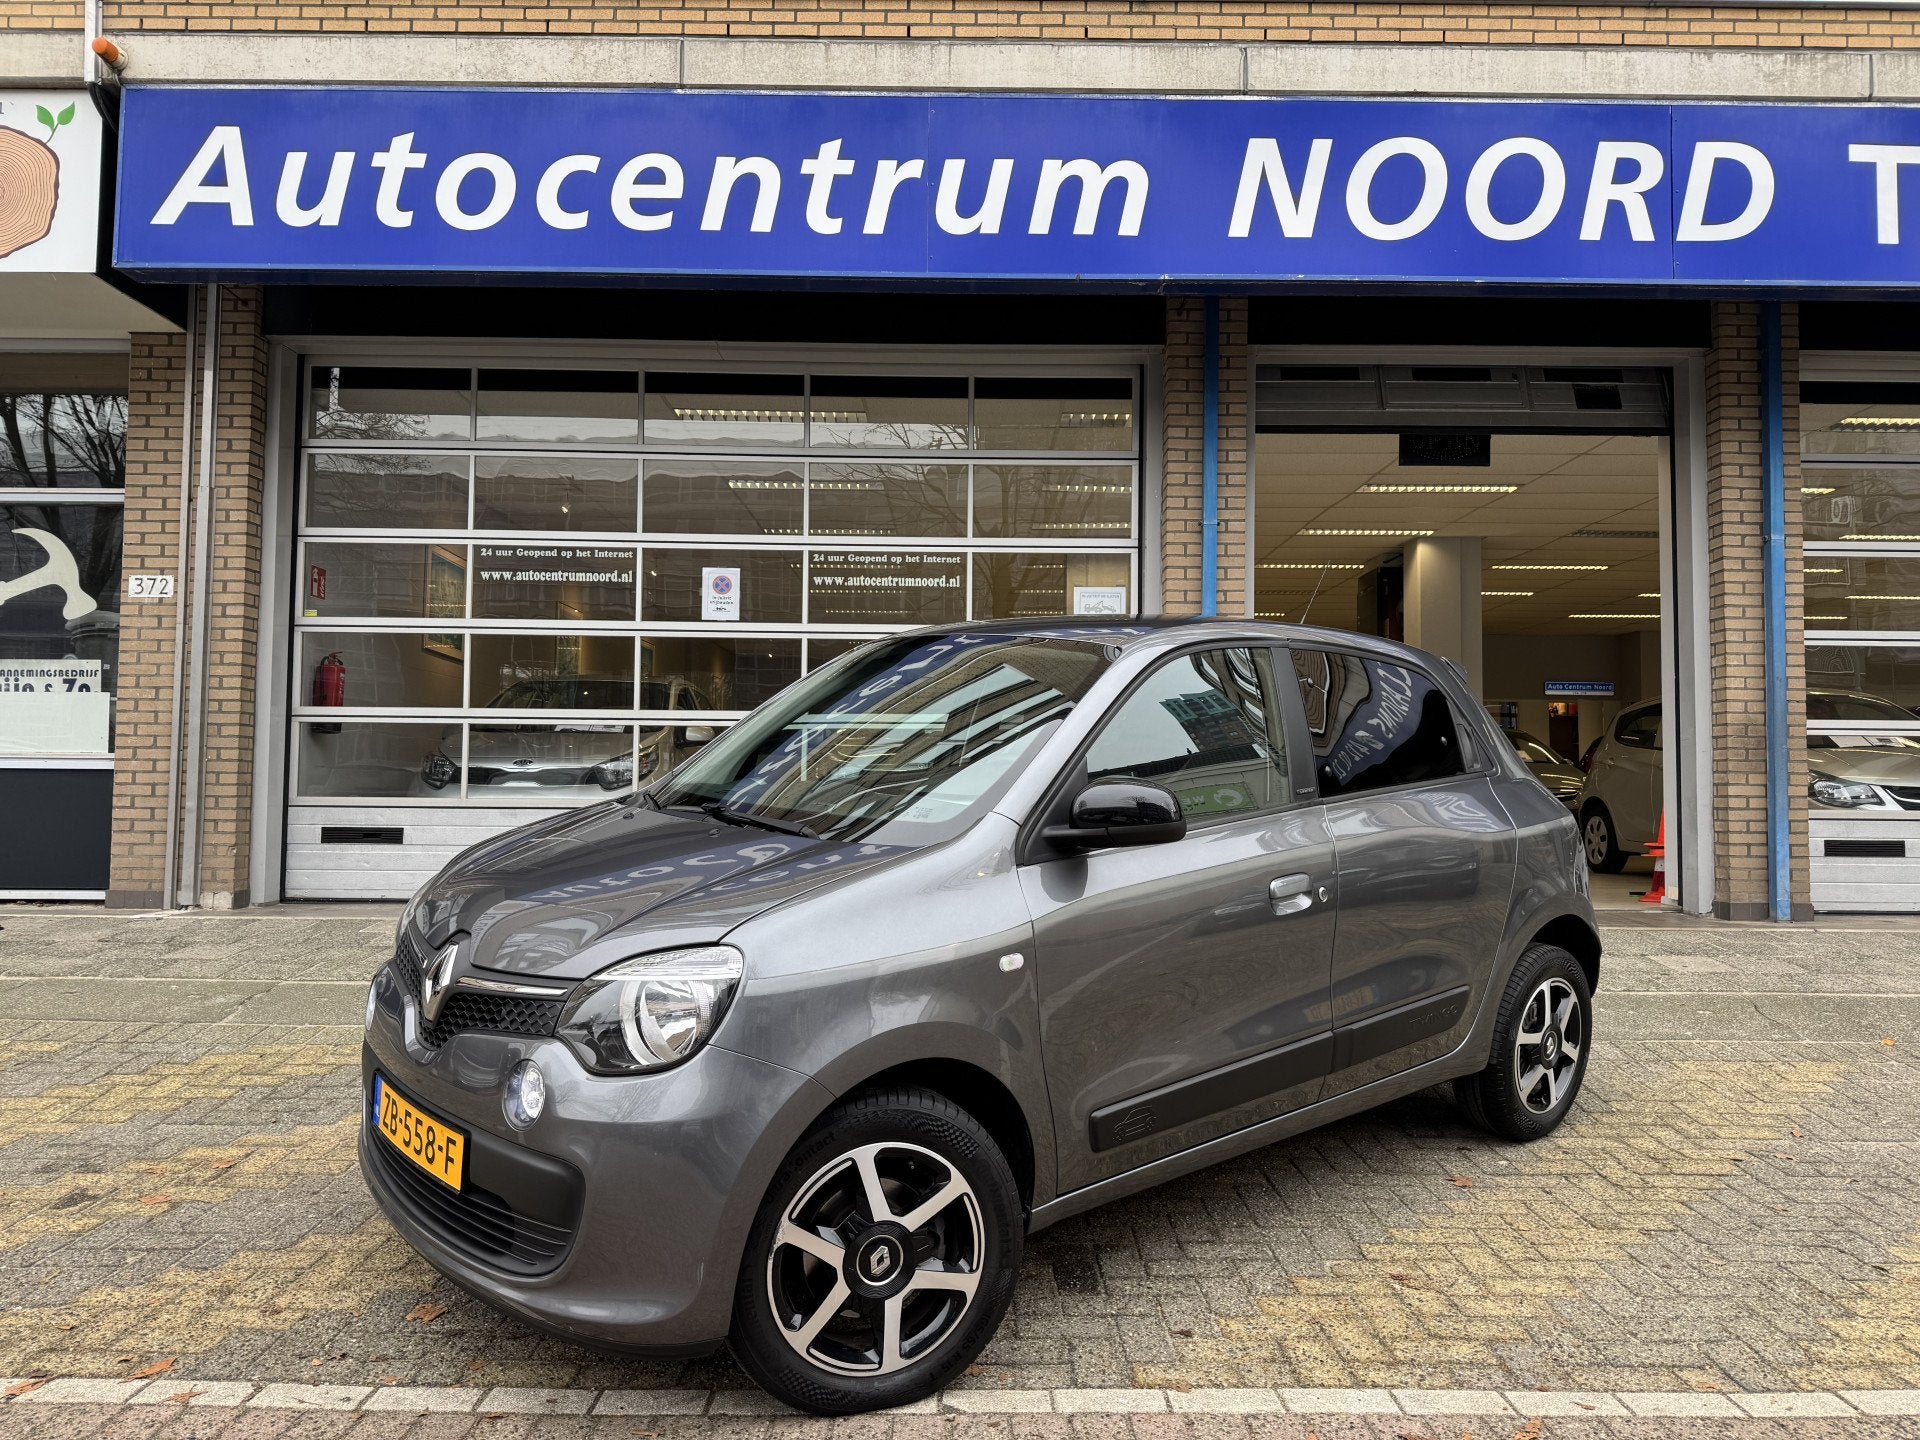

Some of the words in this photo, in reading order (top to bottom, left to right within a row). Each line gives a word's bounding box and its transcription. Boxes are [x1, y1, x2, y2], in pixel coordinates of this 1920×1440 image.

[151, 126, 1149, 236] Autocentrum
[1229, 137, 1775, 242] NOORD
[480, 548, 492, 556] 24
[496, 549, 513, 557] uur
[516, 548, 557, 558] Geopend
[561, 550, 572, 558] op
[576, 548, 591, 557] het
[594, 549, 633, 558] Internet
[813, 554, 824, 562] 24
[848, 554, 887, 563] Geopend
[891, 555, 902, 564] op
[905, 554, 920, 563] het
[923, 555, 960, 563] Internet
[480, 570, 633, 583] www.autocentrumnoord.nl
[813, 575, 960, 587] www.autocentrumnoord.nl
[134, 577, 169, 595] 372
[382, 1091, 457, 1175] ZB-558-F
